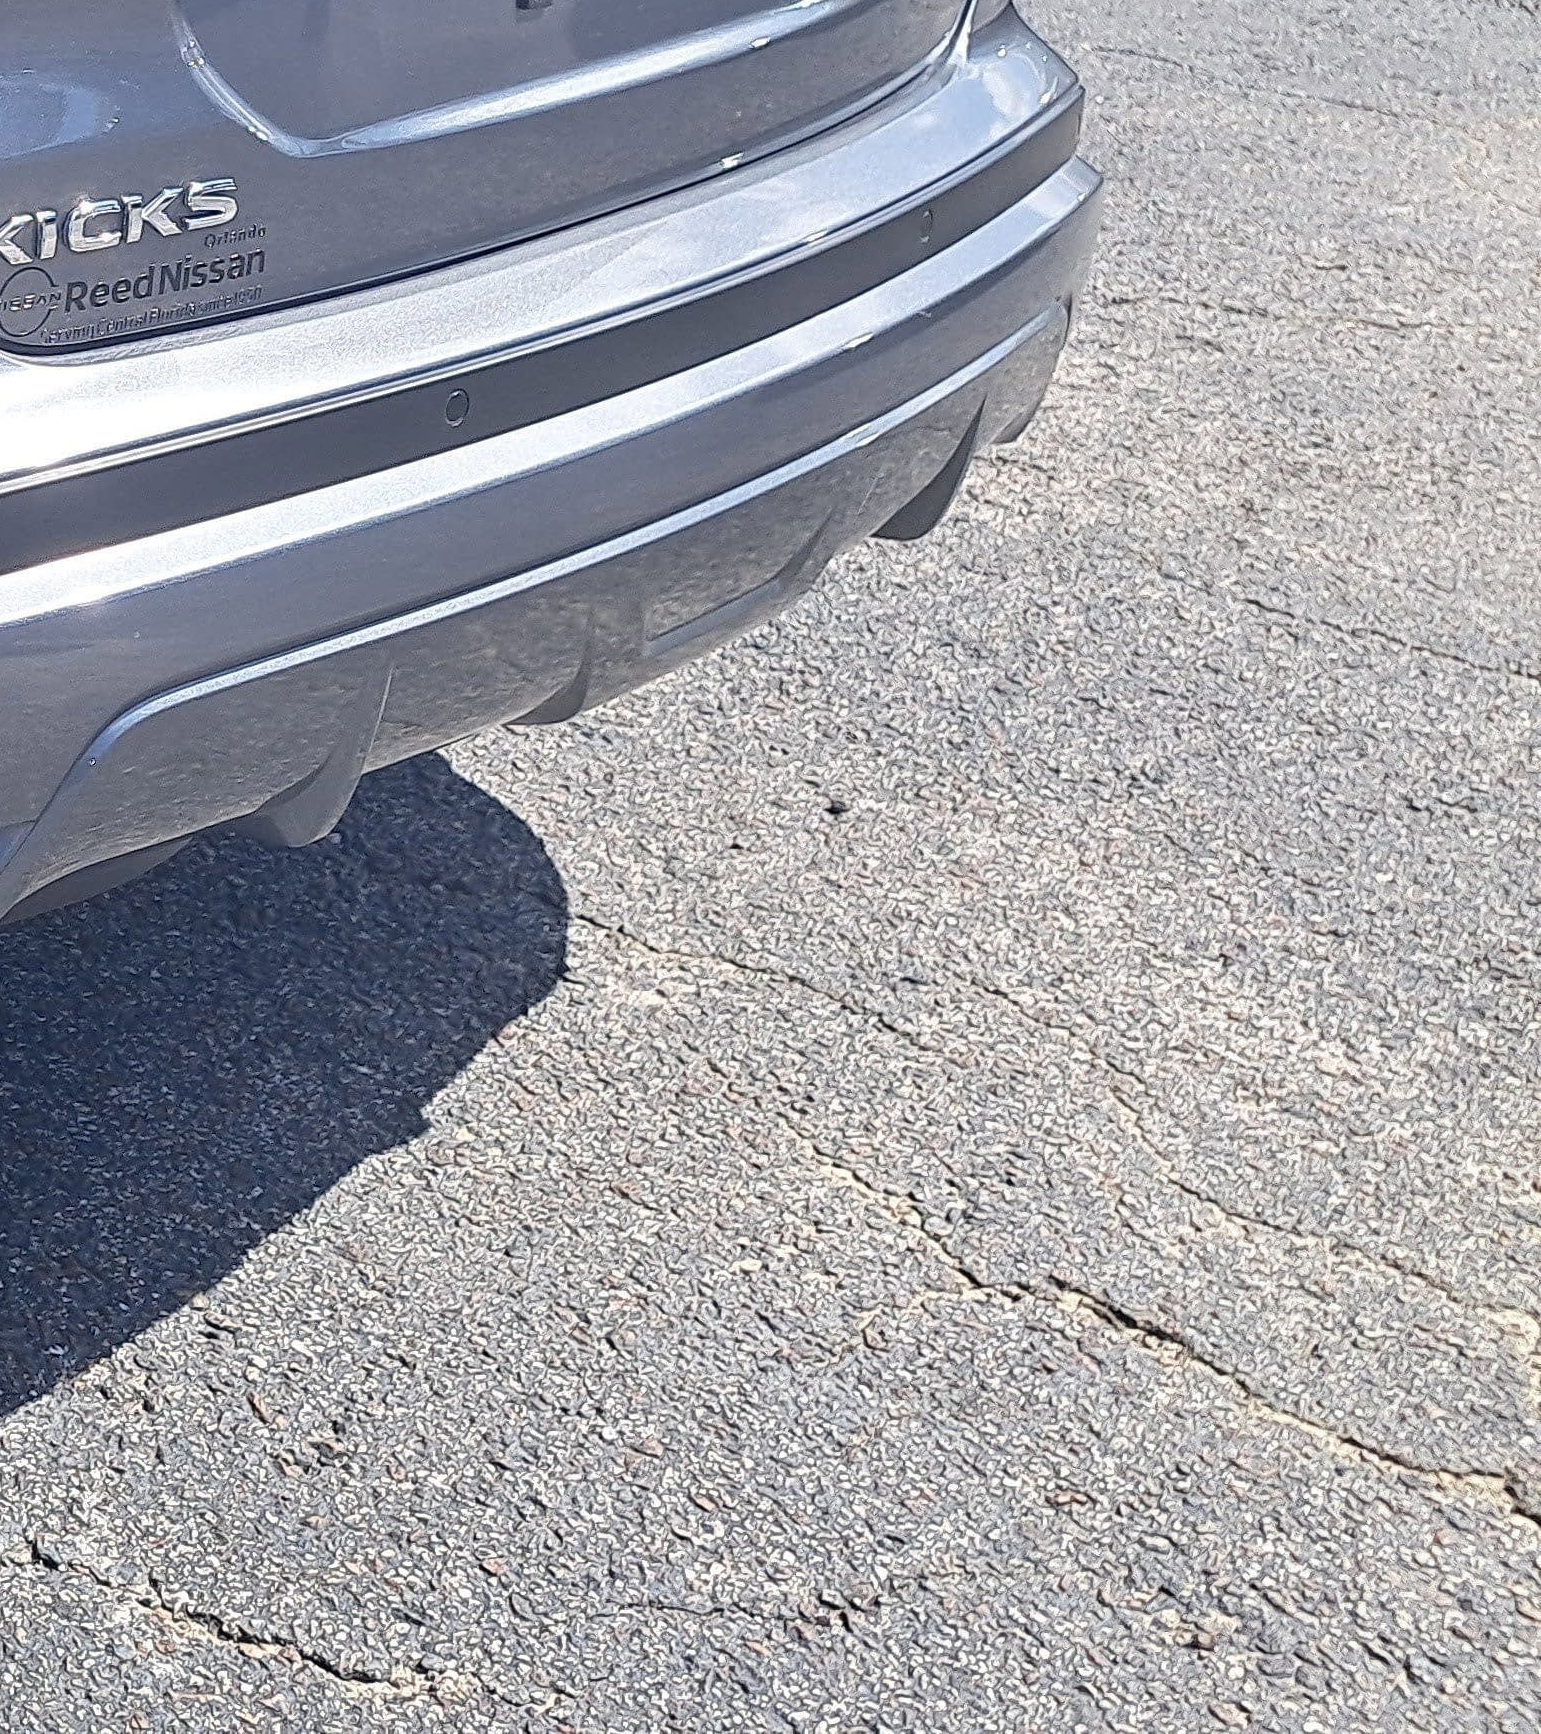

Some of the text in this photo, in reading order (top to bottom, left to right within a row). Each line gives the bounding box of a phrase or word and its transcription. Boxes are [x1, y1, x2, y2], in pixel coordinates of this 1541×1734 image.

[203, 223, 267, 248] Orlando
[63, 246, 265, 314] Reed Nissan
